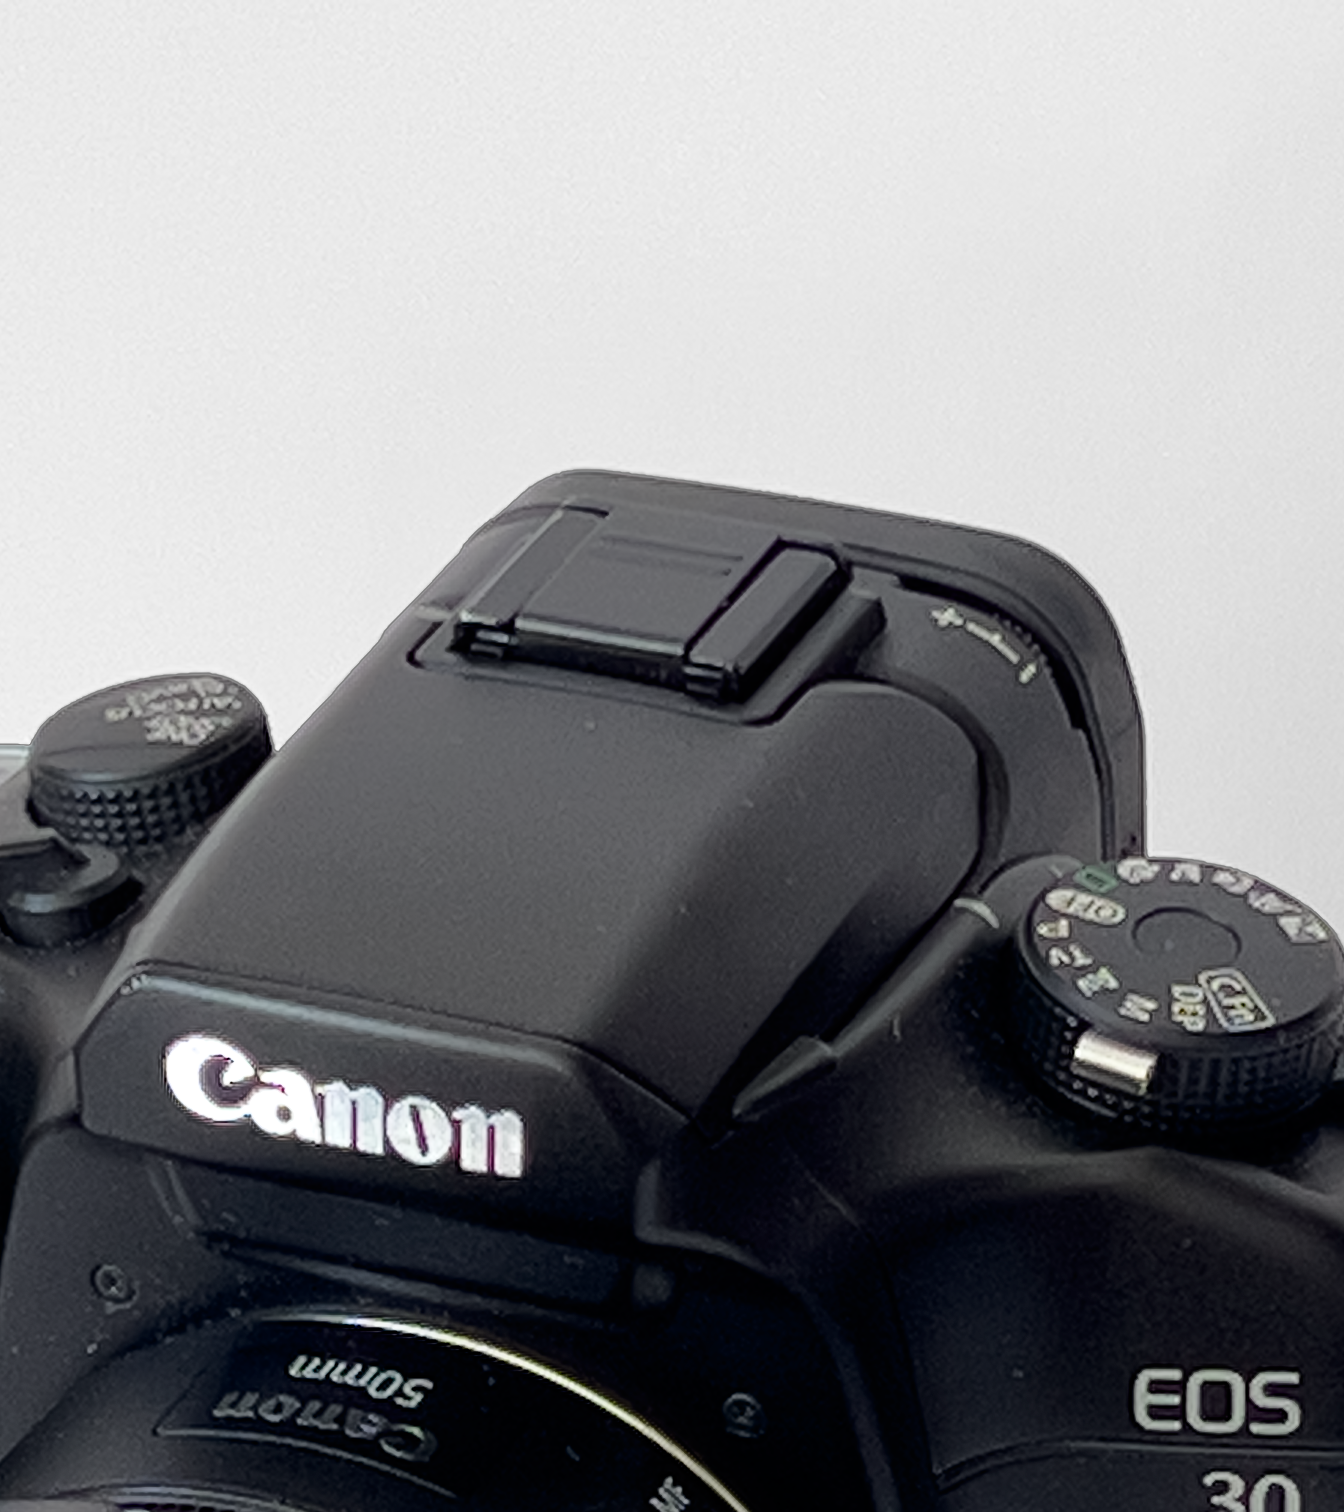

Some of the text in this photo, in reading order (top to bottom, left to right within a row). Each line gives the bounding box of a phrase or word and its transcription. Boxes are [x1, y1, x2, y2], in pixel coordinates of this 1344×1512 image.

[164, 1033, 525, 1179] Canon
[286, 1353, 435, 1410] 50mm
[1132, 1367, 1303, 1436] EOS
[211, 1389, 437, 1462] Canon
